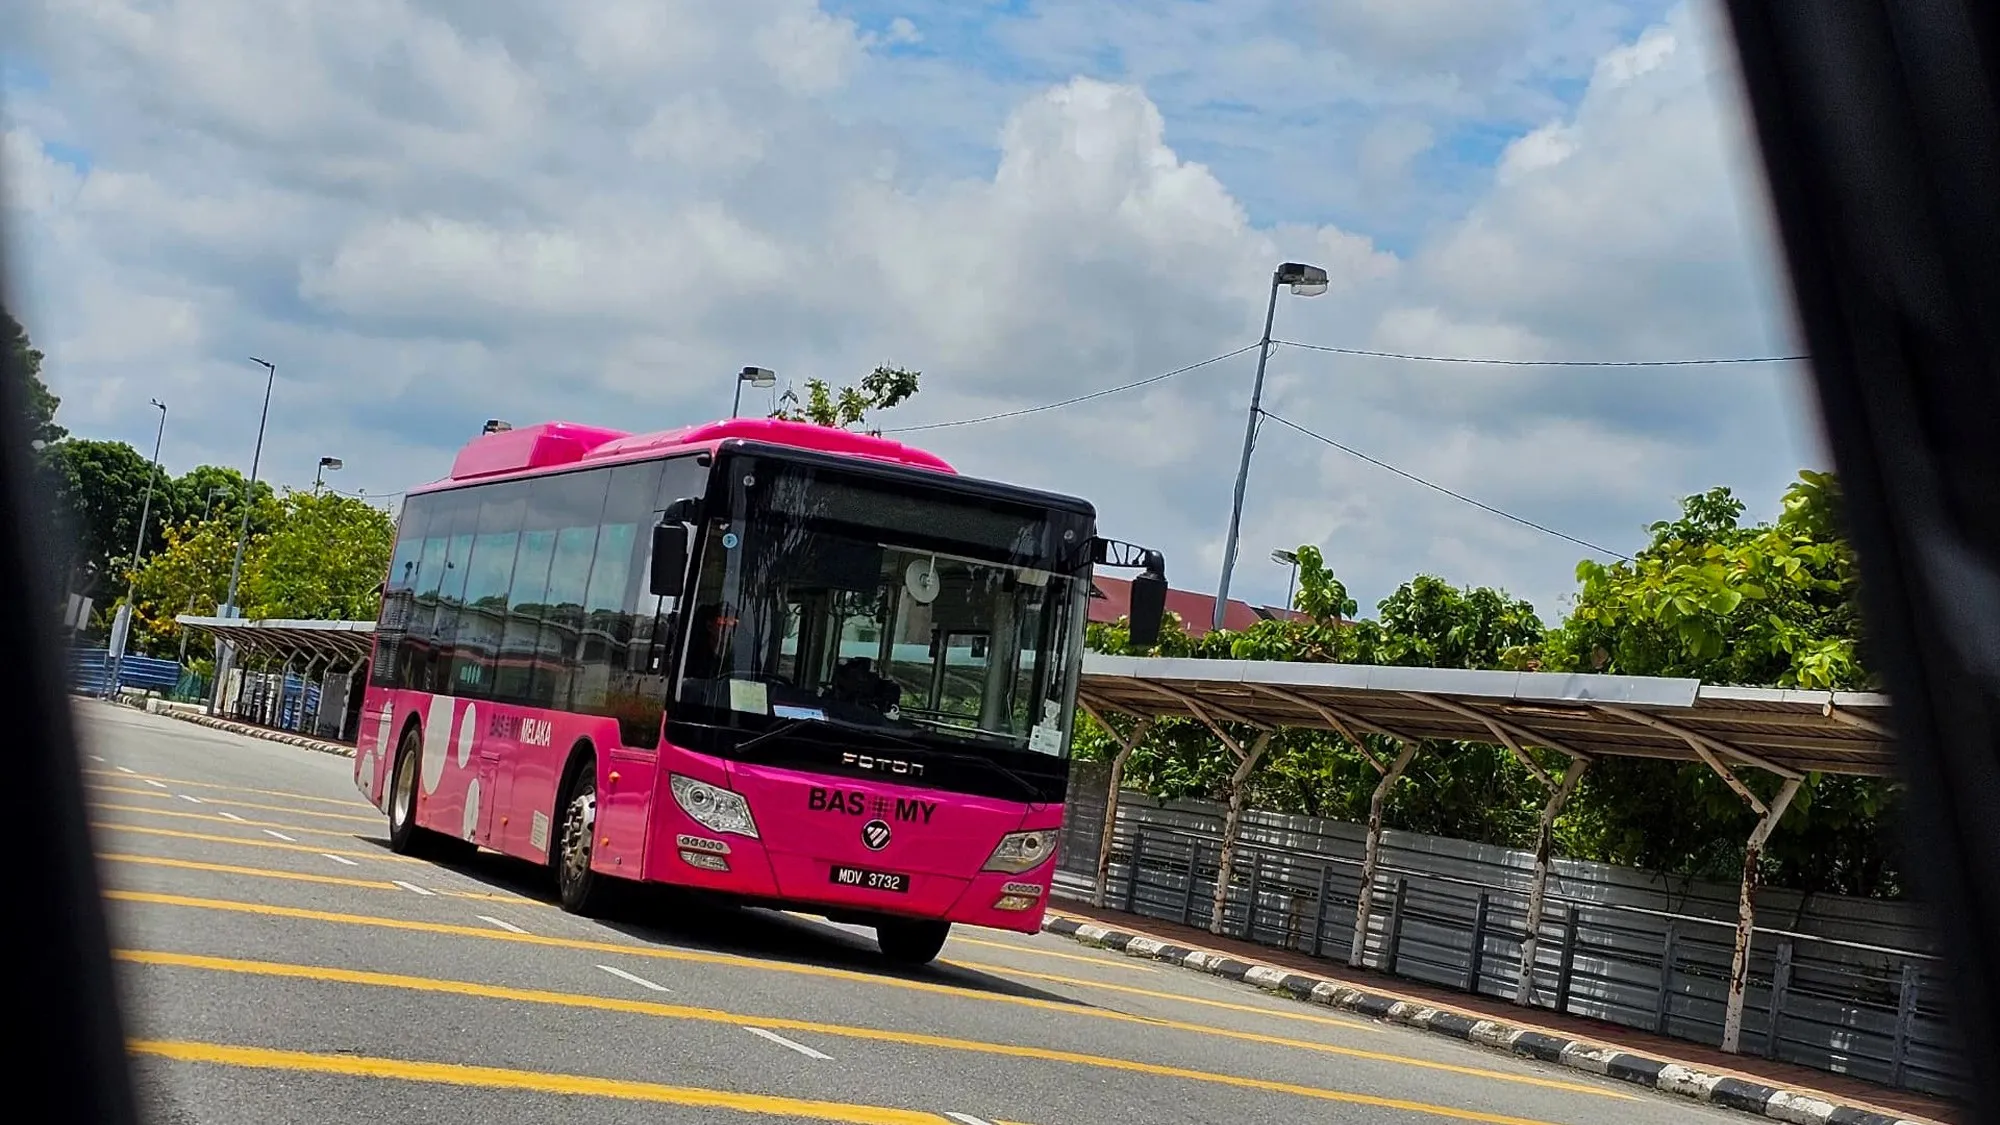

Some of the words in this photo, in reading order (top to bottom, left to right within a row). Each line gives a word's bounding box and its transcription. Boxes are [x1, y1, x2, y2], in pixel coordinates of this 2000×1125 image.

[520, 717, 551, 747] MELAKA
[842, 752, 924, 776] FOTON
[808, 787, 865, 816] BAS
[895, 797, 937, 824] MY
[838, 868, 863, 885] MDV
[868, 872, 900, 890] 3732
